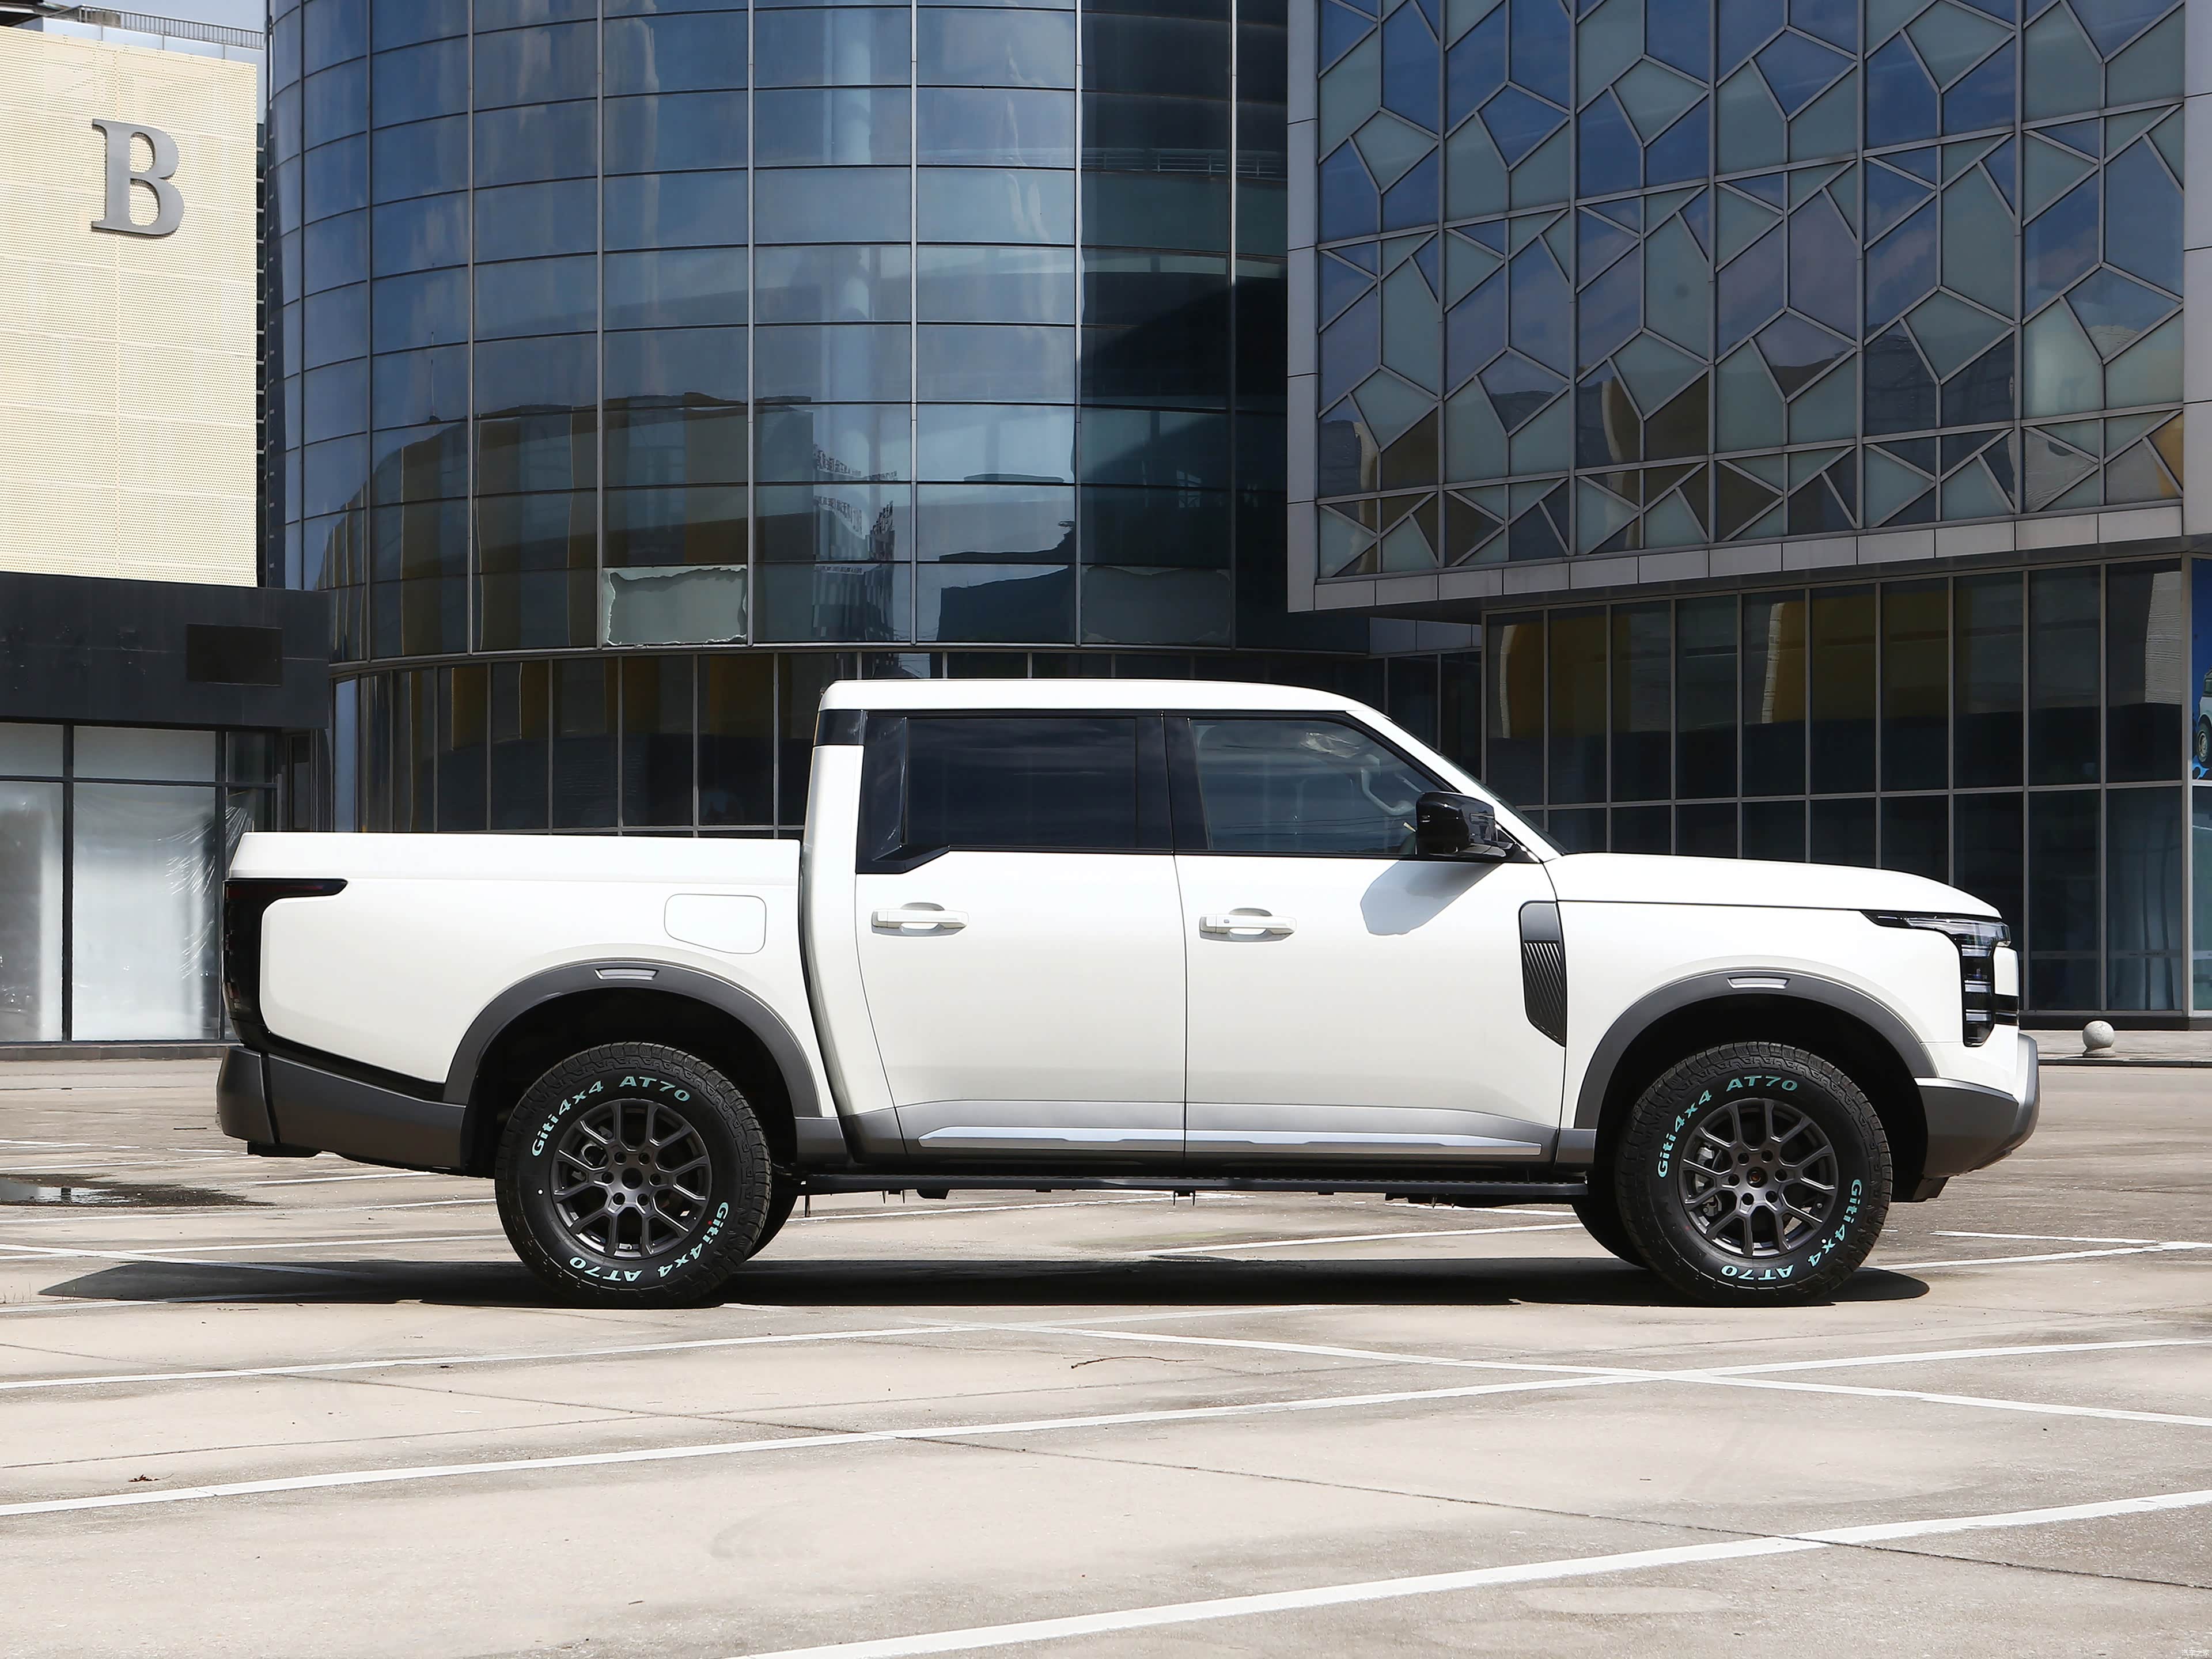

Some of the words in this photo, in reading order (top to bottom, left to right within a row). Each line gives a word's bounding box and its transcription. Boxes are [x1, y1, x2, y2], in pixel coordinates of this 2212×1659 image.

[90, 118, 185, 238] B
[619, 1075, 690, 1102] AT70
[1726, 1075, 1798, 1092] AT70
[569, 1256, 642, 1282] AT70
[1721, 1264, 1794, 1281] AT70
